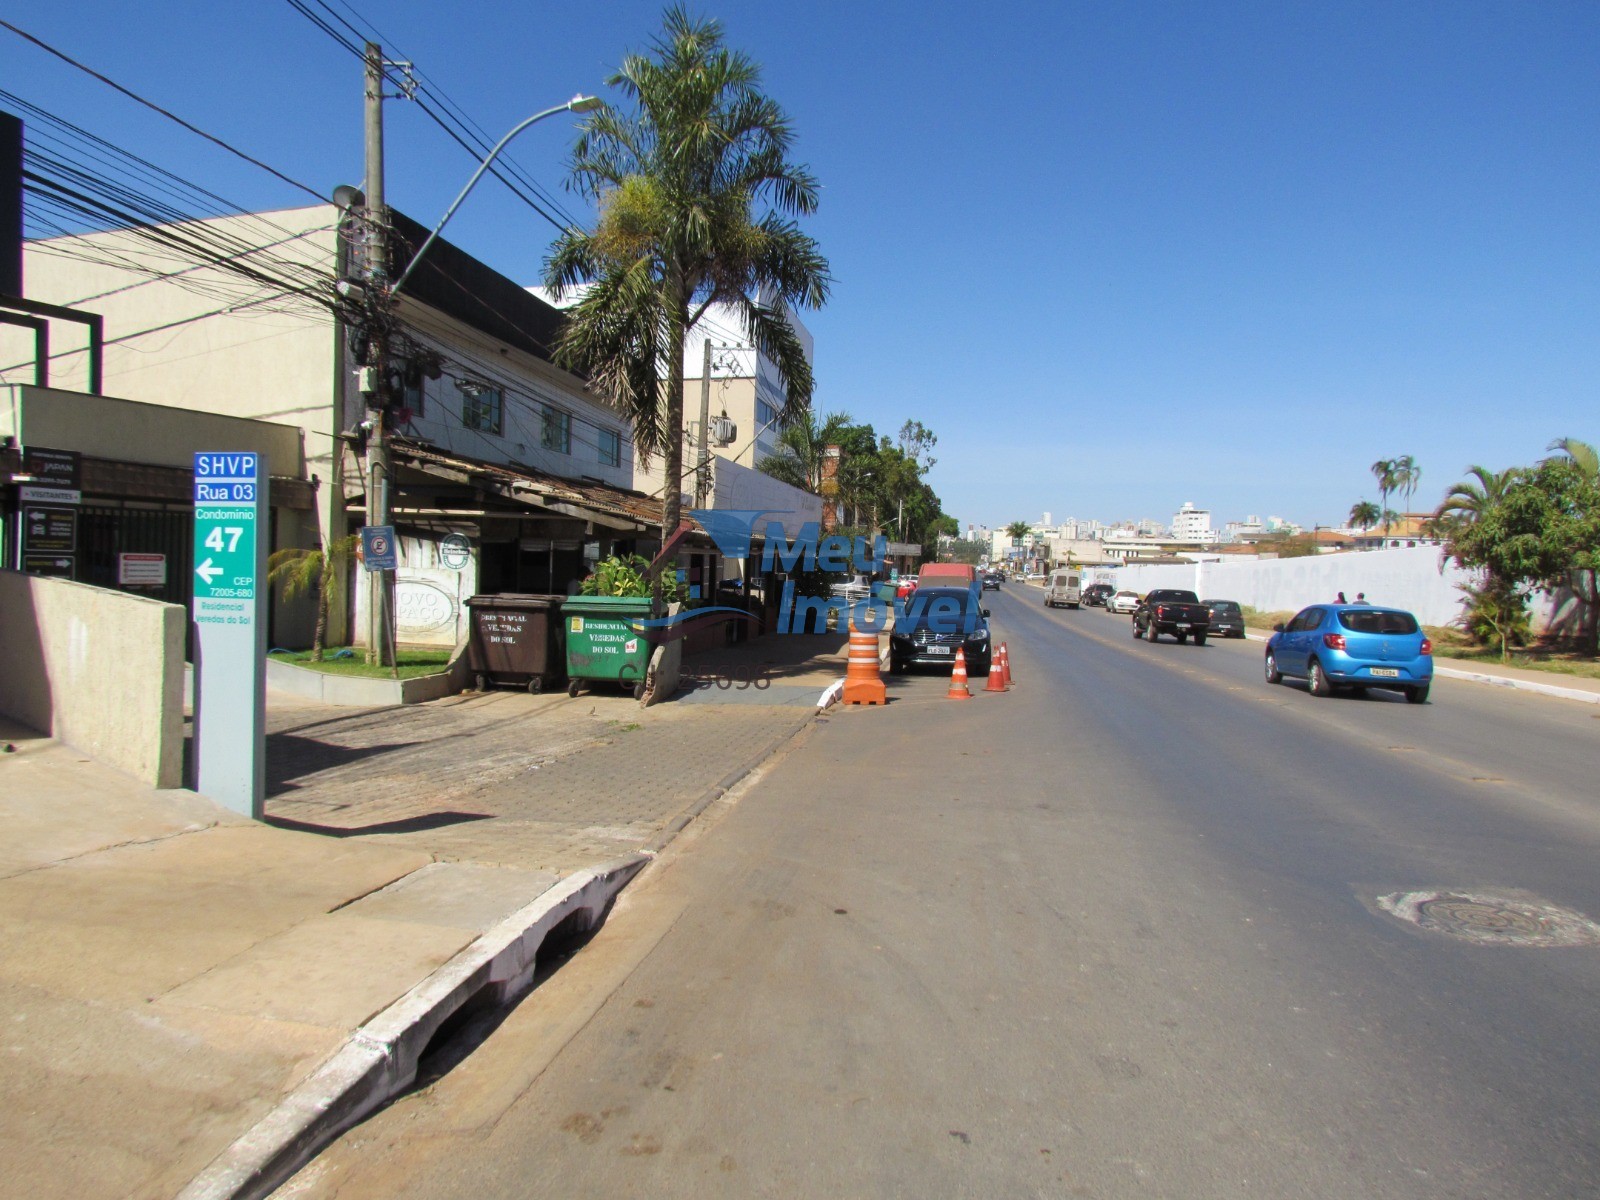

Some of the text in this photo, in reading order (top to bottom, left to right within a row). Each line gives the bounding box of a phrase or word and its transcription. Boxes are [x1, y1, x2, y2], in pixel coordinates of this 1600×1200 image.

[44, 461, 73, 473] JAPAN
[198, 456, 254, 475] SHVP
[30, 489, 72, 500] VISITANTES
[197, 484, 254, 500] Rua 03
[204, 526, 244, 553] 47
[233, 577, 253, 586] CEP
[210, 587, 253, 598] 72005-680
[397, 592, 438, 608] OVO
[201, 602, 245, 612] Residencial
[196, 614, 251, 625] Veredas do Sol
[585, 622, 629, 630] RESIDENCIAL
[589, 633, 625, 642] VEREDAS
[592, 646, 603, 654] DO
[604, 646, 619, 654] SOL
